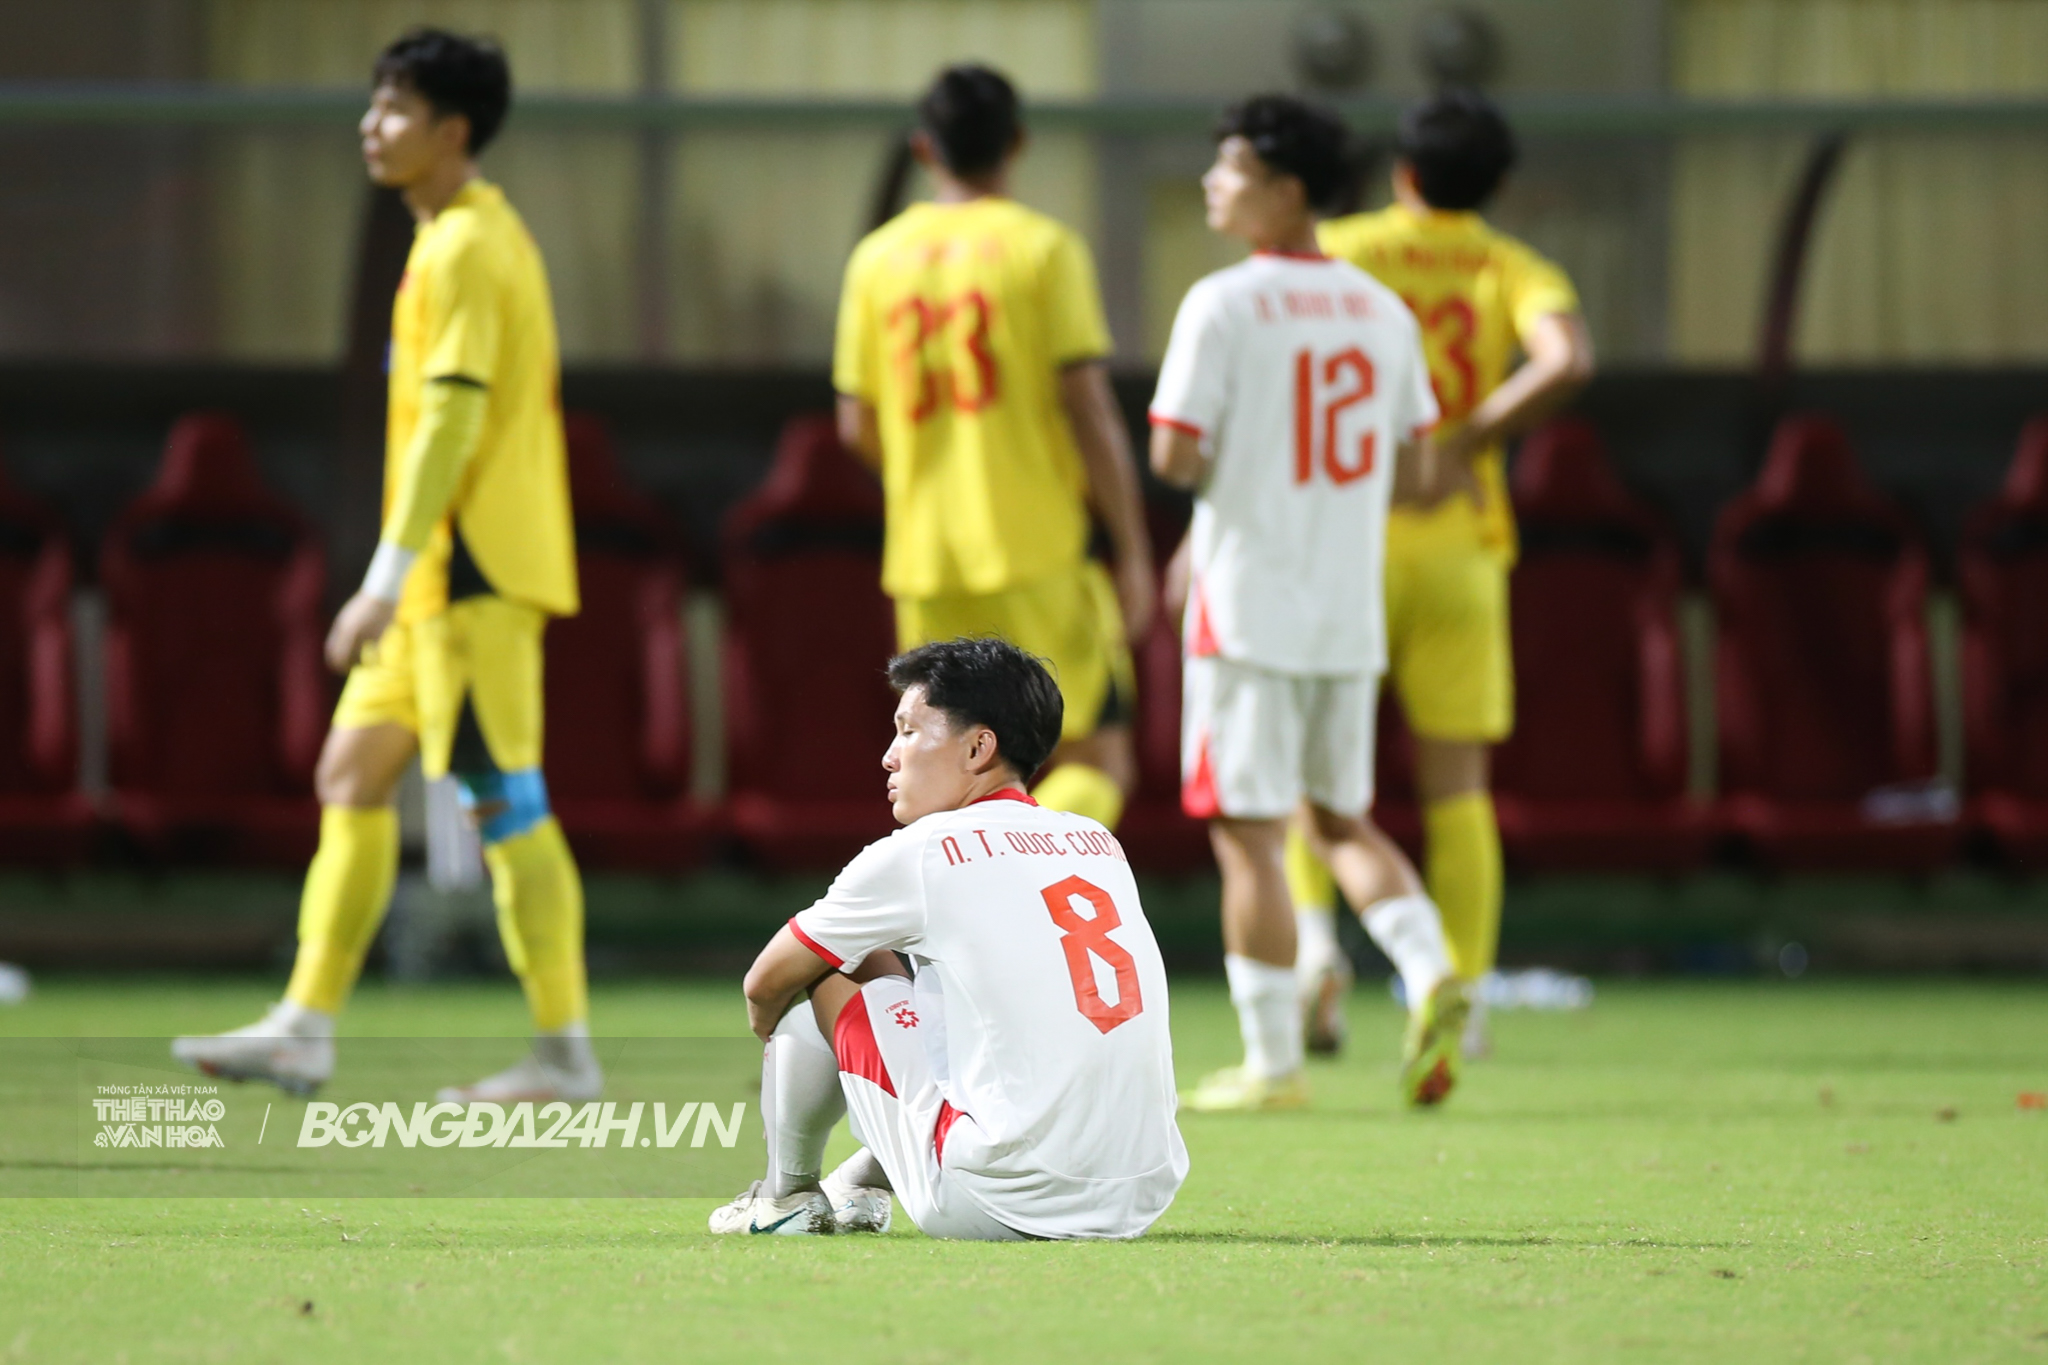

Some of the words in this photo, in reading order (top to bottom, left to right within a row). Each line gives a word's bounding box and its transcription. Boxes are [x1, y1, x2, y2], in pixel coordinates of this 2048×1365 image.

[1294, 344, 1375, 488] 12
[1402, 292, 1477, 420] 3
[972, 829, 1005, 858] T.
[1004, 831, 1067, 856] QUOC
[1040, 874, 1143, 1035] 8
